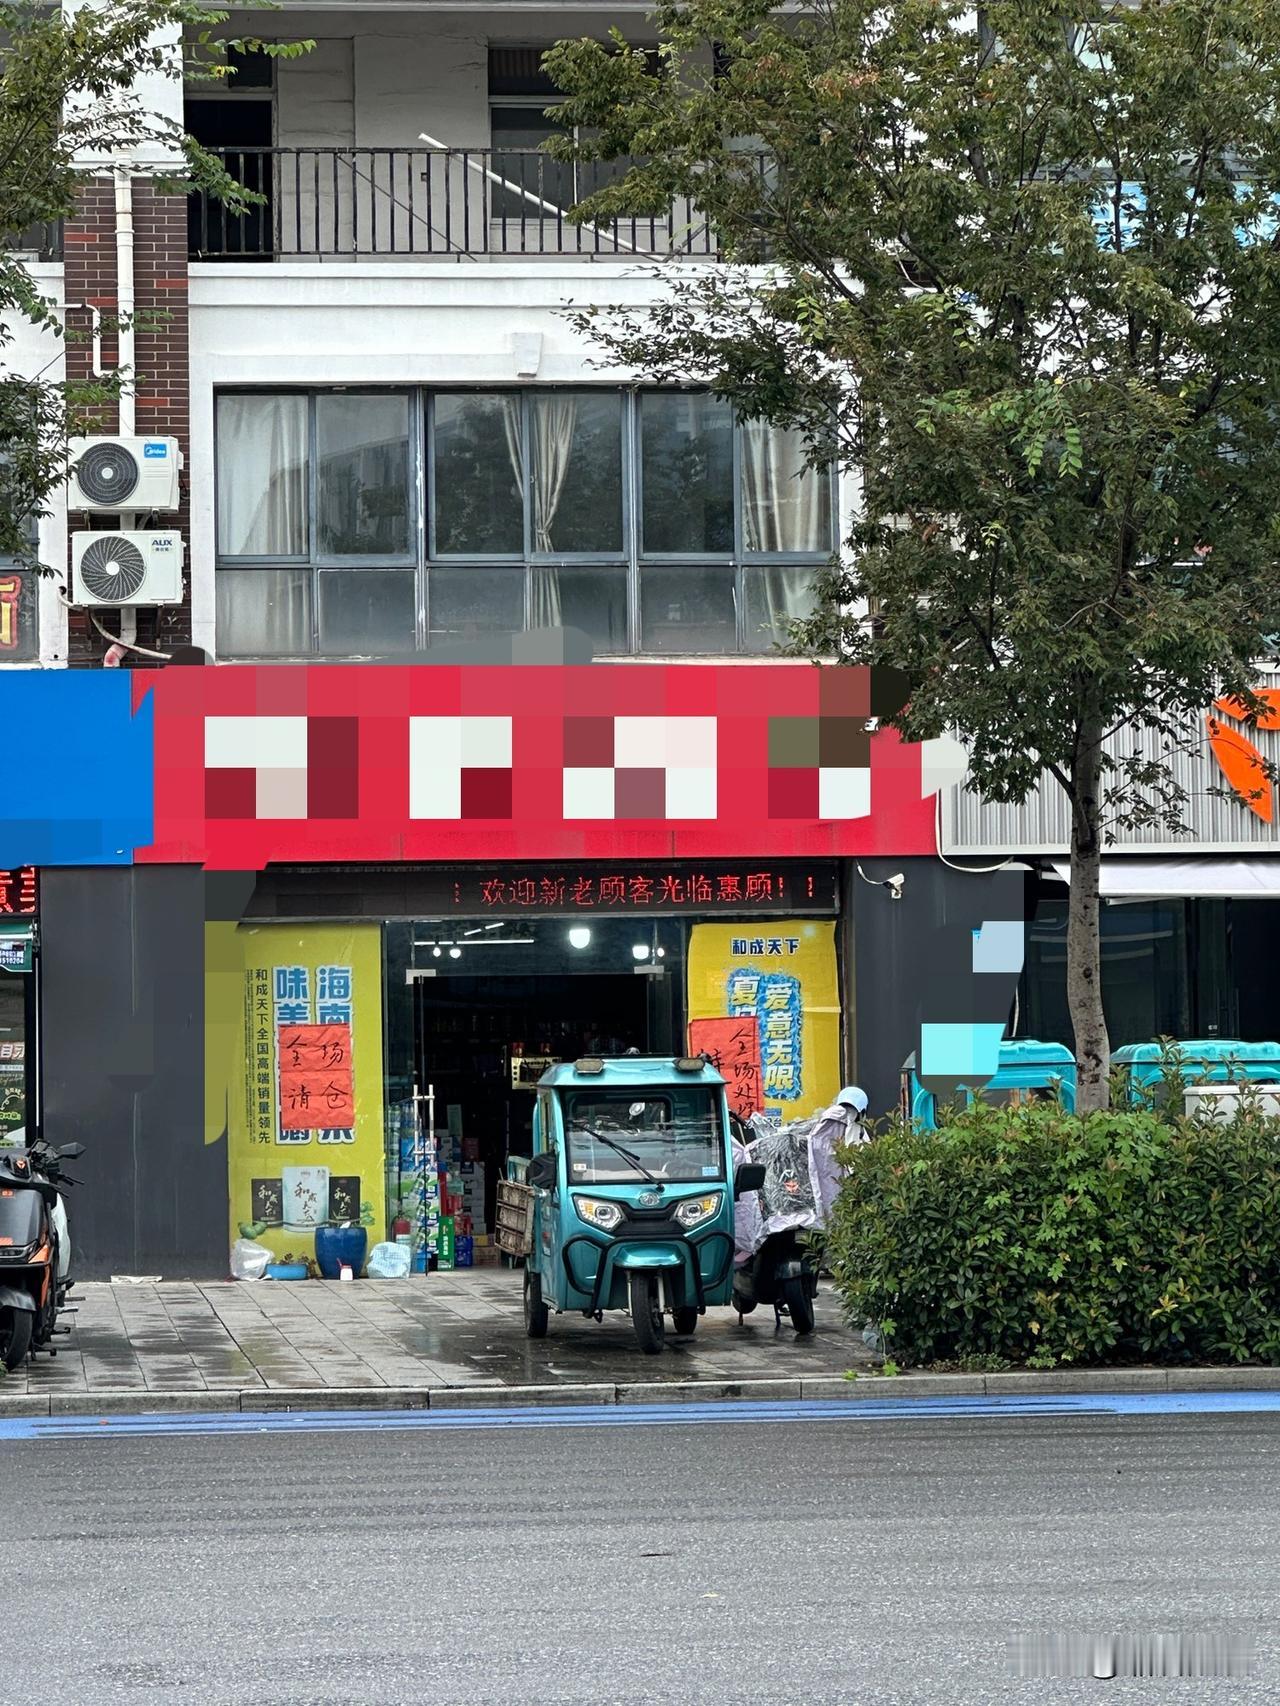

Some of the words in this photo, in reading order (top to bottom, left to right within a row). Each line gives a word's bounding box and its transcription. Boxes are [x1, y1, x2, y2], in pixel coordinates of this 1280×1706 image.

[731, 938, 800, 956] 和成天下
[255, 968, 271, 1144] 和成天下全国高端销量领先
[764, 982, 795, 1091] 爱意无限
[287, 1080, 349, 1110] 清仓
